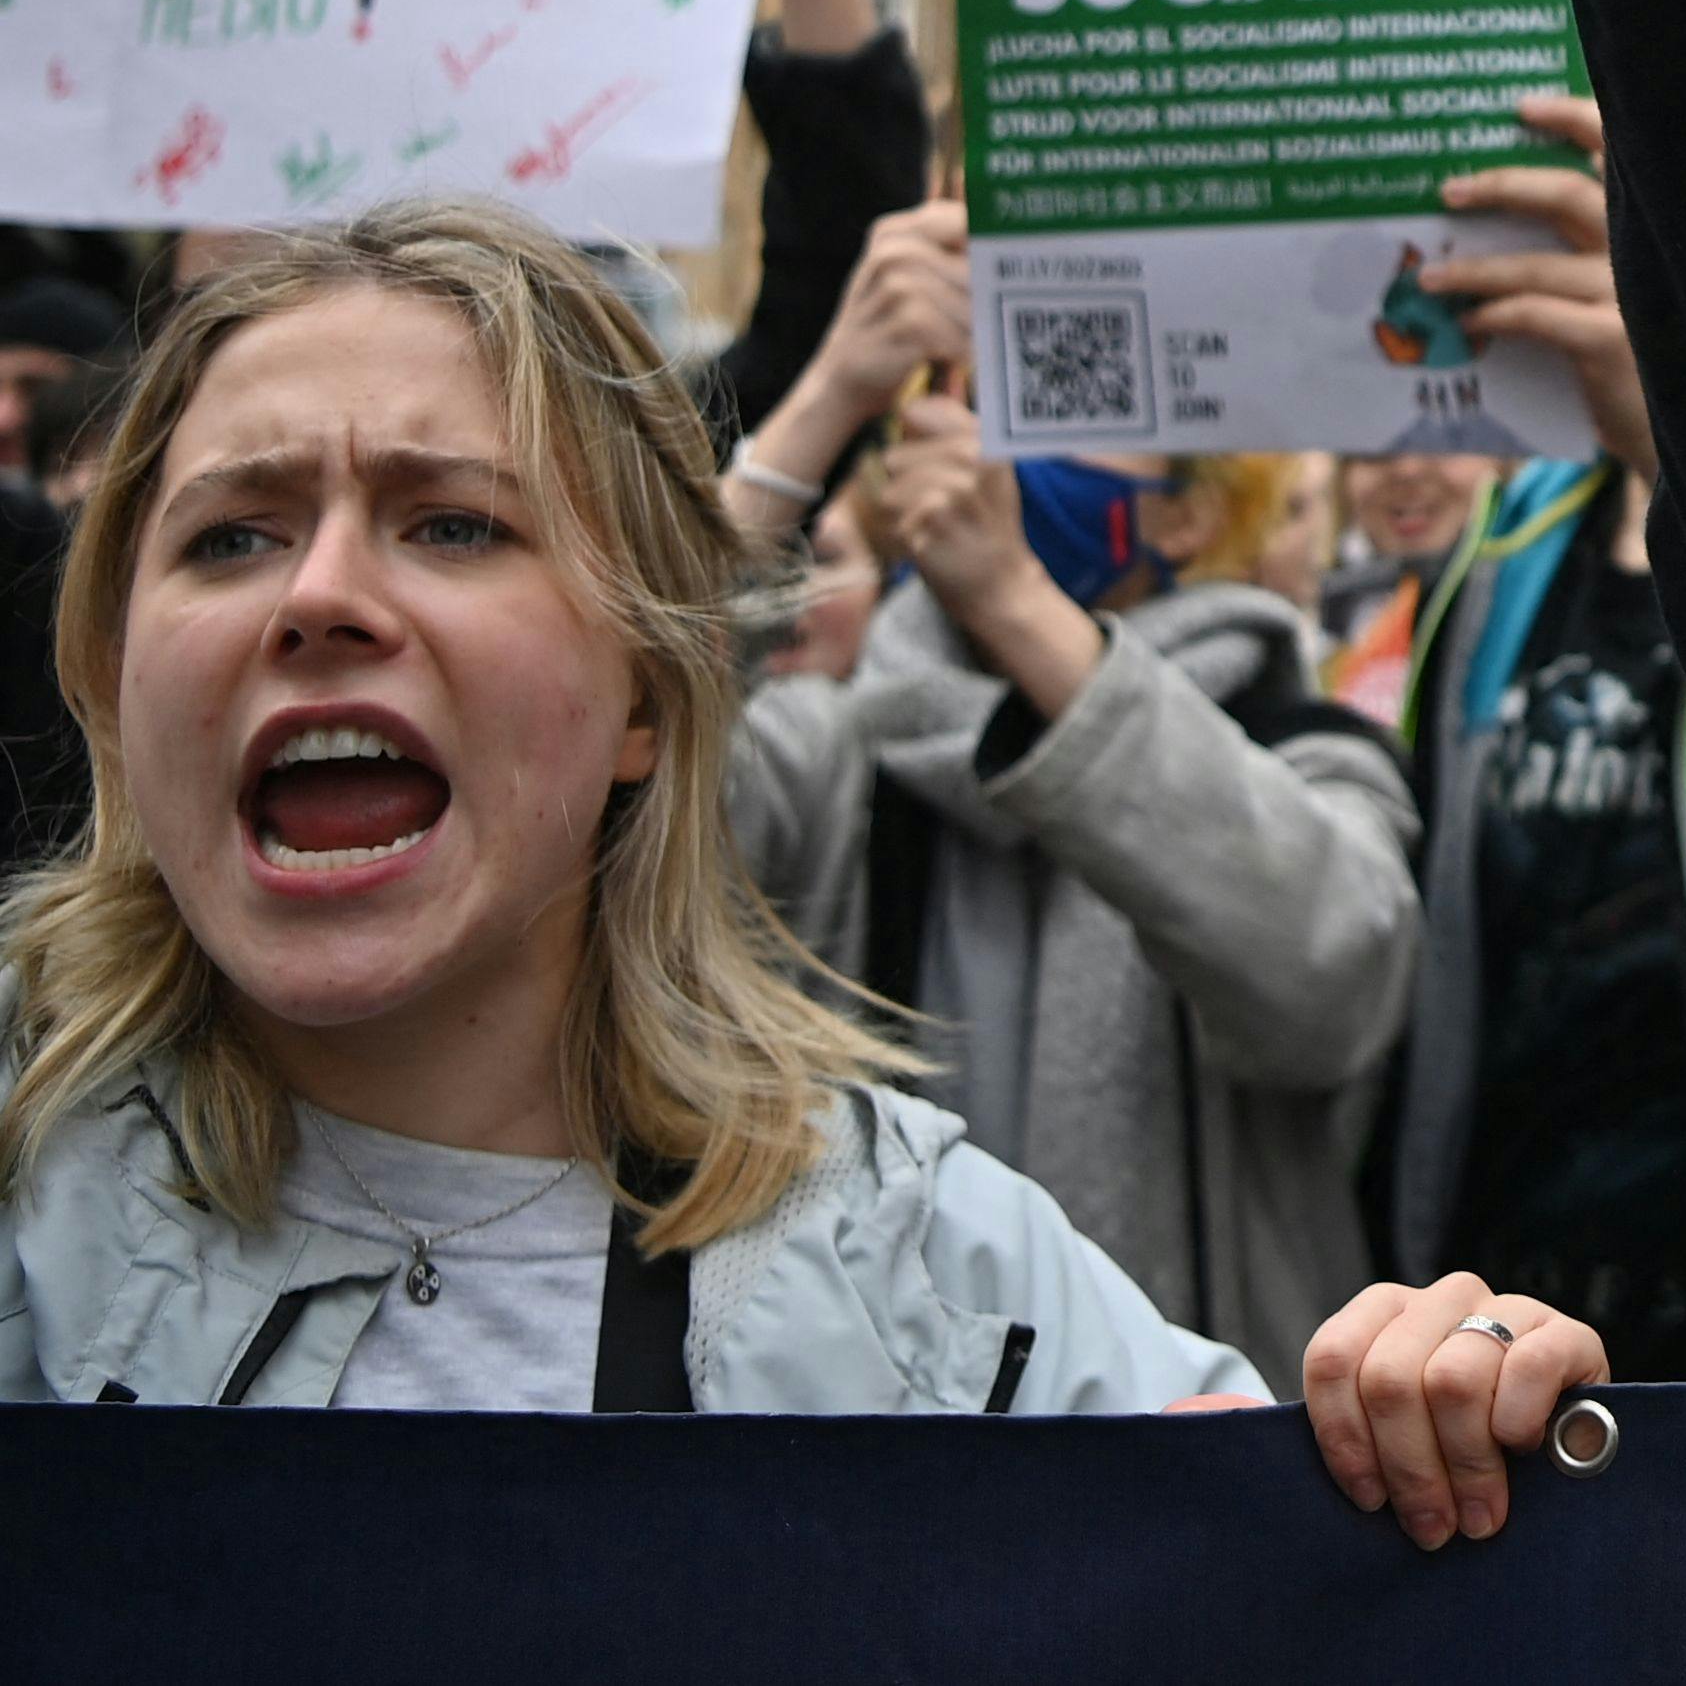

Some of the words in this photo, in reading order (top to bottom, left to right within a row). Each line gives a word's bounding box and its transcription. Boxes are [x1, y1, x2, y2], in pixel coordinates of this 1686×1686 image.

[1082, 27, 1139, 56] POR
[1144, 25, 1174, 53] EL
[1178, 14, 1343, 51] SOCIALISMO
[988, 71, 1063, 103] LUTTE
[1067, 68, 1142, 98] POUR
[1146, 67, 1176, 94] LE
[1182, 54, 1340, 90] SOCIALISME
[1347, 45, 1568, 84] INTERNATIONAL!
[1081, 104, 1161, 136] VOOR
[1041, 137, 1270, 174] INTERNATIONALEN
[1276, 126, 1442, 164] SOZIALISMUS
